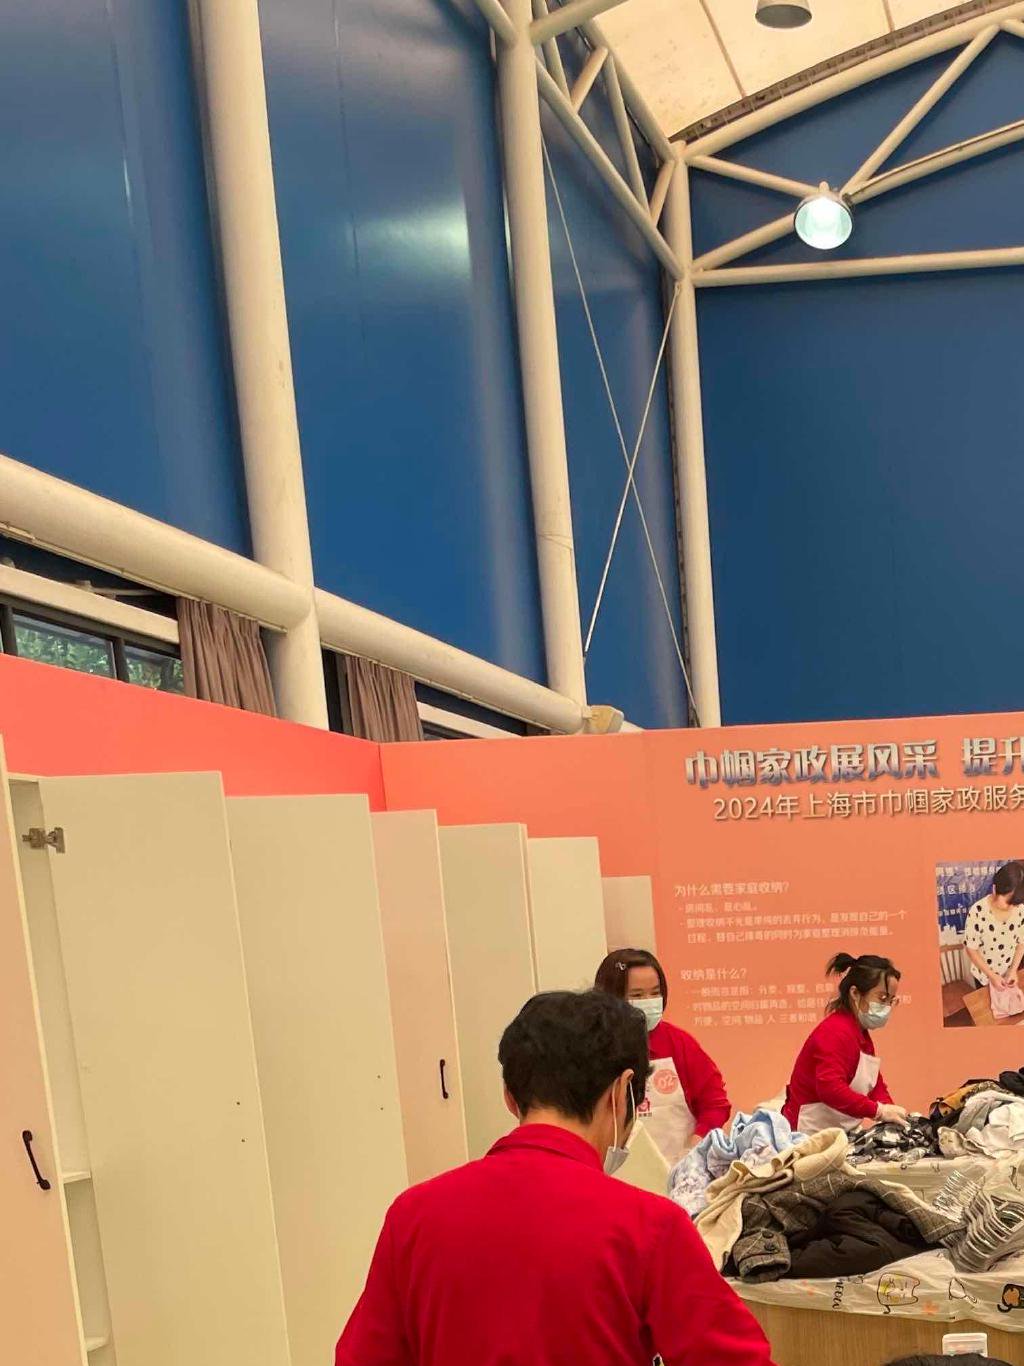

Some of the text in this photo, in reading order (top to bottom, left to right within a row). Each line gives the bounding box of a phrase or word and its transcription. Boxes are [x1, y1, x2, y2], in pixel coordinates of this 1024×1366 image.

[685, 740, 940, 789] 巾帼家政展风采
